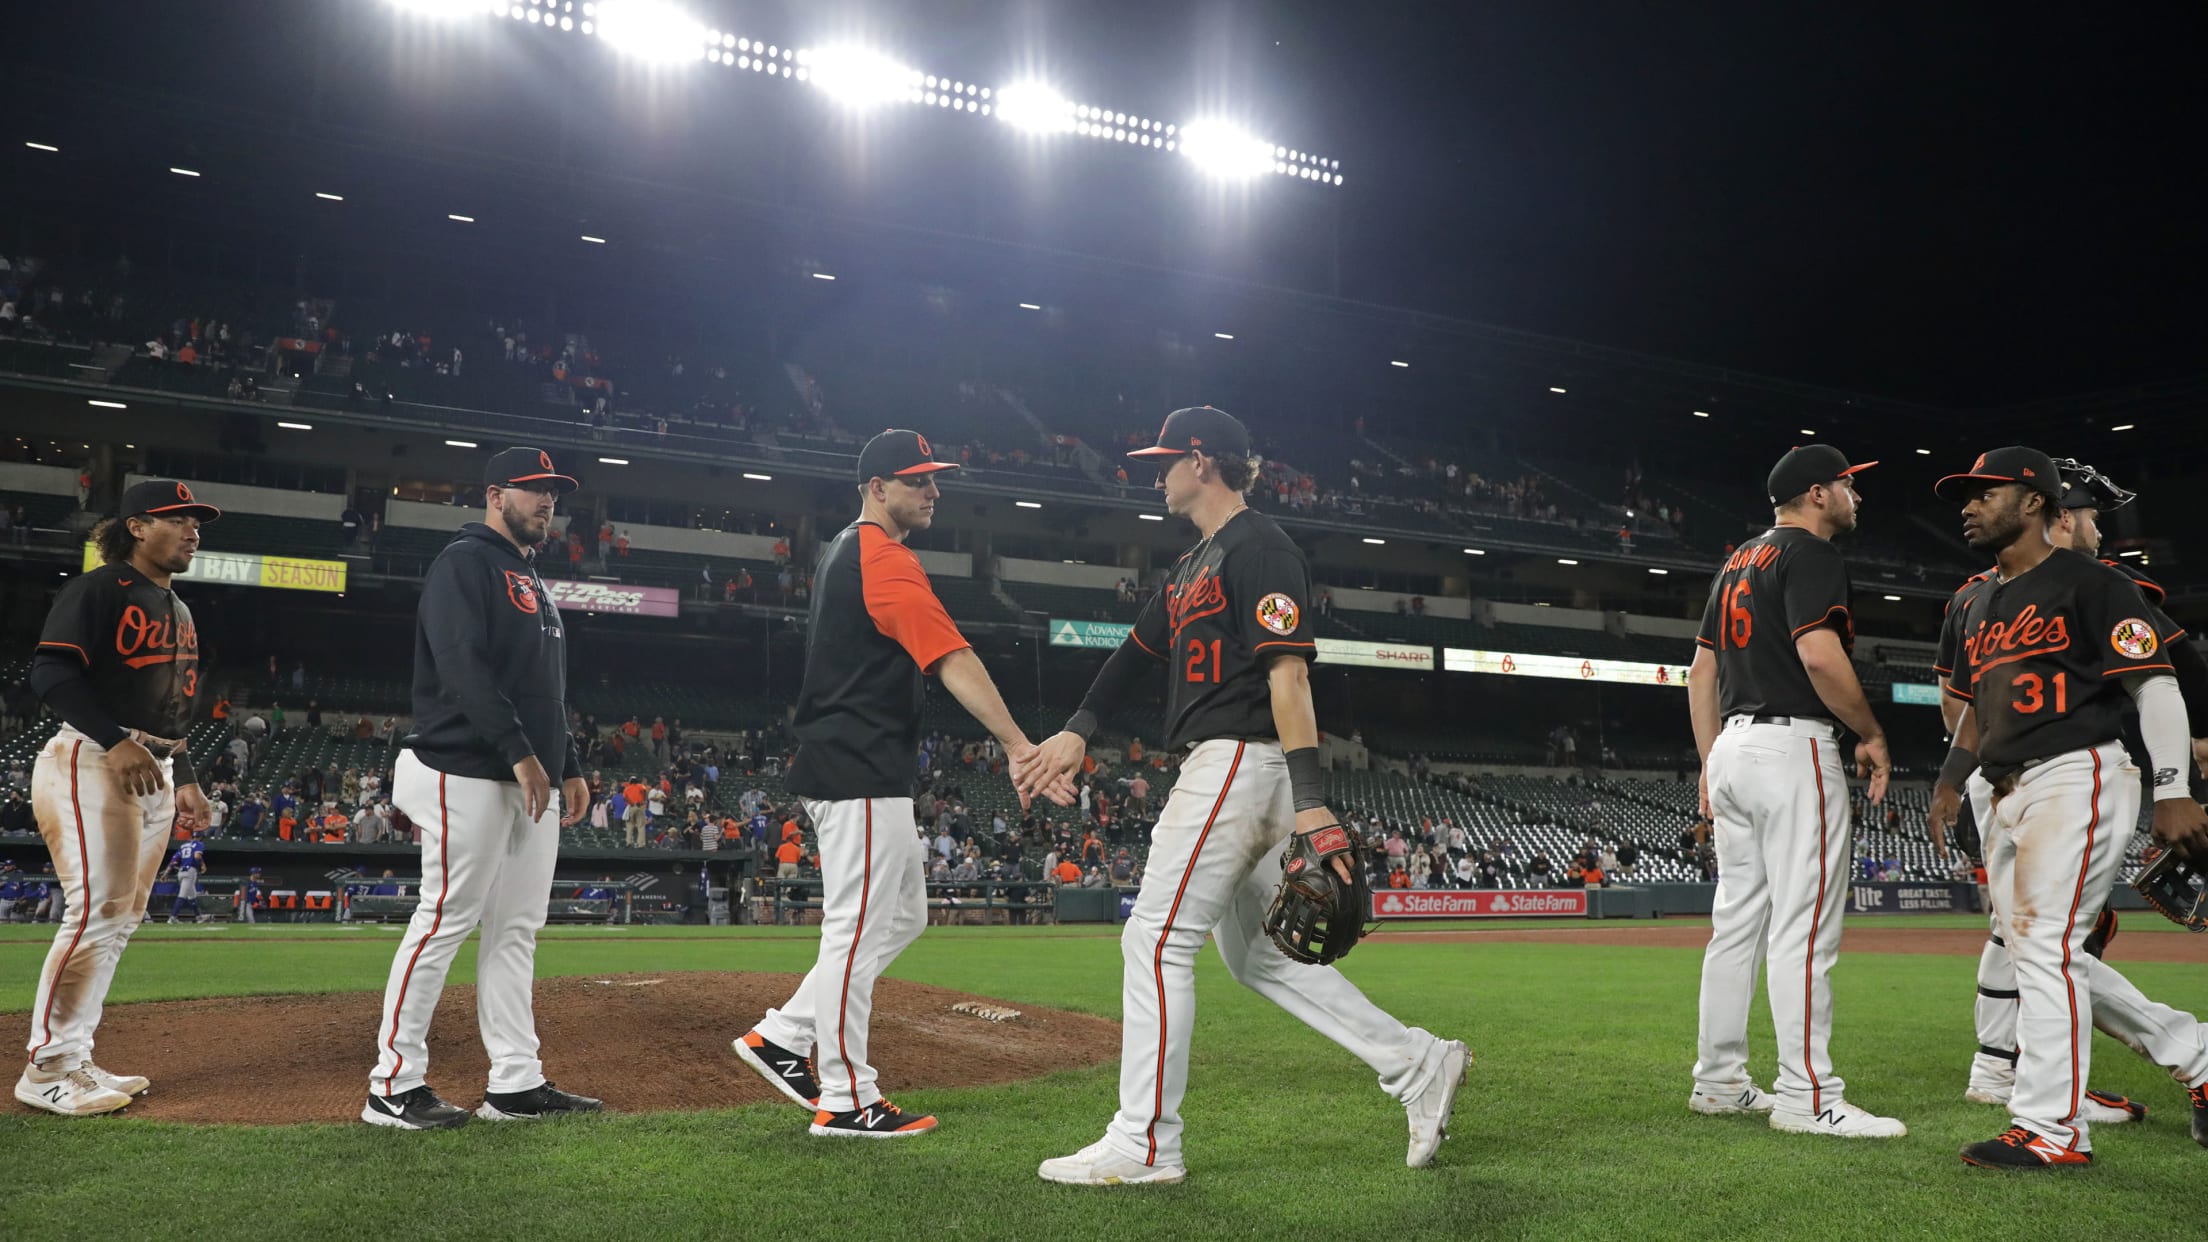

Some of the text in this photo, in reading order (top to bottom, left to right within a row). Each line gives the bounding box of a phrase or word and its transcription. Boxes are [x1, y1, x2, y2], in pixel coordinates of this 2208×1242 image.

[204, 557, 253, 581] BAY
[267, 562, 339, 588] SEASON
[1720, 578, 1752, 651] 16
[1965, 604, 2070, 666] rioles
[1187, 639, 1221, 683] 21
[1376, 650, 1430, 662] SHARP
[2012, 672, 2066, 713] 31
[1854, 886, 1883, 911] Lite
[1897, 889, 1923, 899] GREAT
[1900, 899, 1920, 909] LESS
